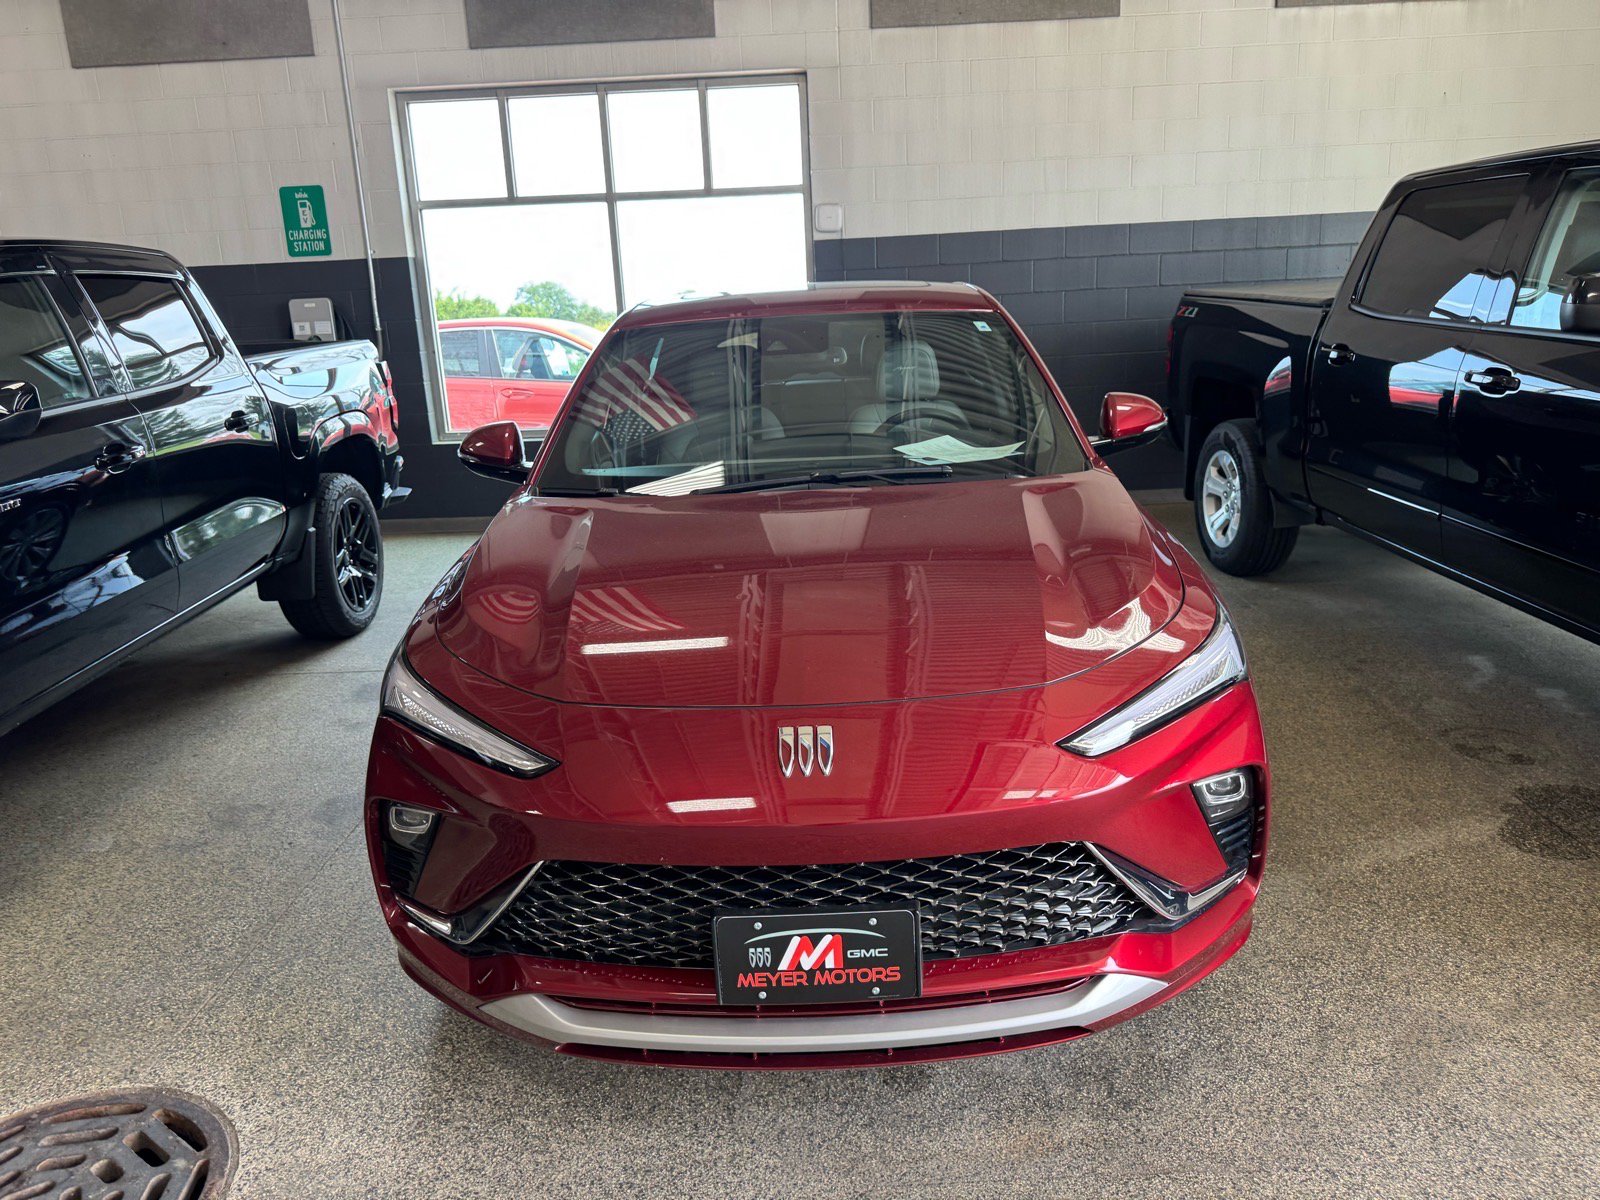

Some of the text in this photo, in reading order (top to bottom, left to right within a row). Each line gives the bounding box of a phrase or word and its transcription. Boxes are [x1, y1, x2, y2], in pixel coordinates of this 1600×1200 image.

[288, 229, 327, 240] CHARGING
[293, 241, 325, 252] STATION
[847, 948, 889, 958] GMC
[737, 966, 901, 988] MEYER MOTORS
